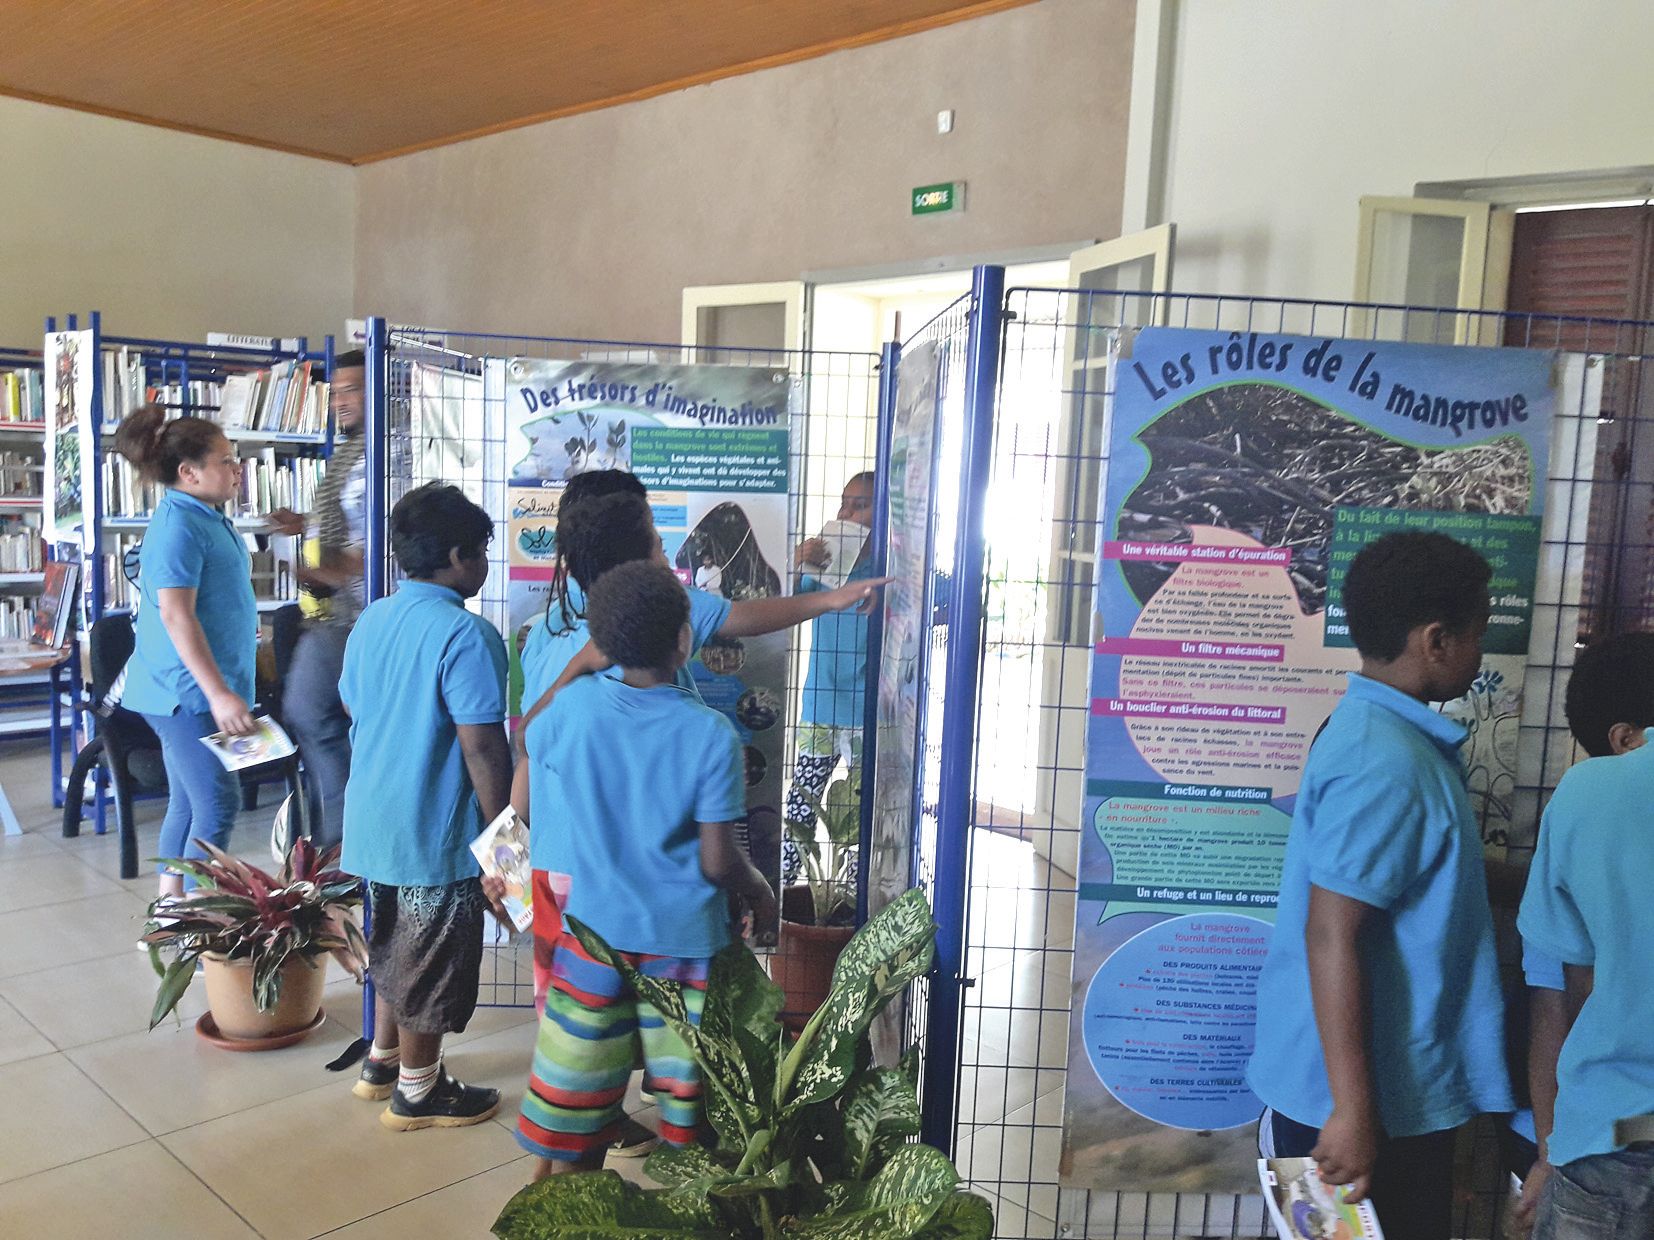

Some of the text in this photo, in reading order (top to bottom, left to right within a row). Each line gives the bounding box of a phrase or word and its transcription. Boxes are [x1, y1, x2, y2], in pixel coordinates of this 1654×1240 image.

[1132, 332, 1529, 438] Les rôles de la mangrove
[520, 378, 777, 426] Des trésors d'imagination
[633, 429, 647, 437] Les
[722, 431, 735, 440] qui
[671, 454, 684, 462] Les
[687, 455, 717, 465] espèces
[719, 456, 754, 465] végétales
[757, 456, 764, 464] et
[767, 456, 781, 464] ani-
[657, 466, 669, 476] qui
[671, 468, 676, 476] y
[703, 467, 716, 475] ont
[729, 468, 770, 478] développer
[662, 477, 717, 487] d'imaginations
[719, 480, 739, 488] pour
[739, 479, 776, 488] s'adapter.
[1338, 511, 1536, 532] Du fait de leur position tampon,
[1336, 530, 1343, 541] à
[1348, 531, 1359, 542] la
[1123, 544, 1286, 563] Une véritable station d'épuration
[1182, 566, 1192, 574] La
[1195, 568, 1238, 578] mangrove
[1241, 568, 1255, 576] est
[1173, 578, 1245, 590] filtre biologique.
[1181, 642, 1280, 659] Un filtre mécanique
[1110, 700, 1281, 718] Un bouclier anti-érosion du littoral
[1143, 745, 1162, 755] joue
[1185, 747, 1202, 755] rôle
[1208, 748, 1259, 757] anti-érosion
[1266, 750, 1301, 759] efficace
[1164, 785, 1267, 799] Fonction de nutrition
[1123, 805, 1169, 813] mangrove
[1206, 806, 1234, 814] milieu
[1238, 807, 1261, 815] riche
[1121, 815, 1168, 823] nourriture
[1137, 888, 1150, 898] Un
[1153, 888, 1184, 901] refuge
[1187, 890, 1197, 899] et
[1200, 892, 1212, 900] un
[1215, 891, 1233, 901] lieu
[1235, 891, 1247, 901] de
[1191, 923, 1250, 934] La mangrove
[1175, 934, 1265, 943] fournit directement
[1179, 945, 1232, 956] populations
[1180, 962, 1217, 970] PRODUITS
